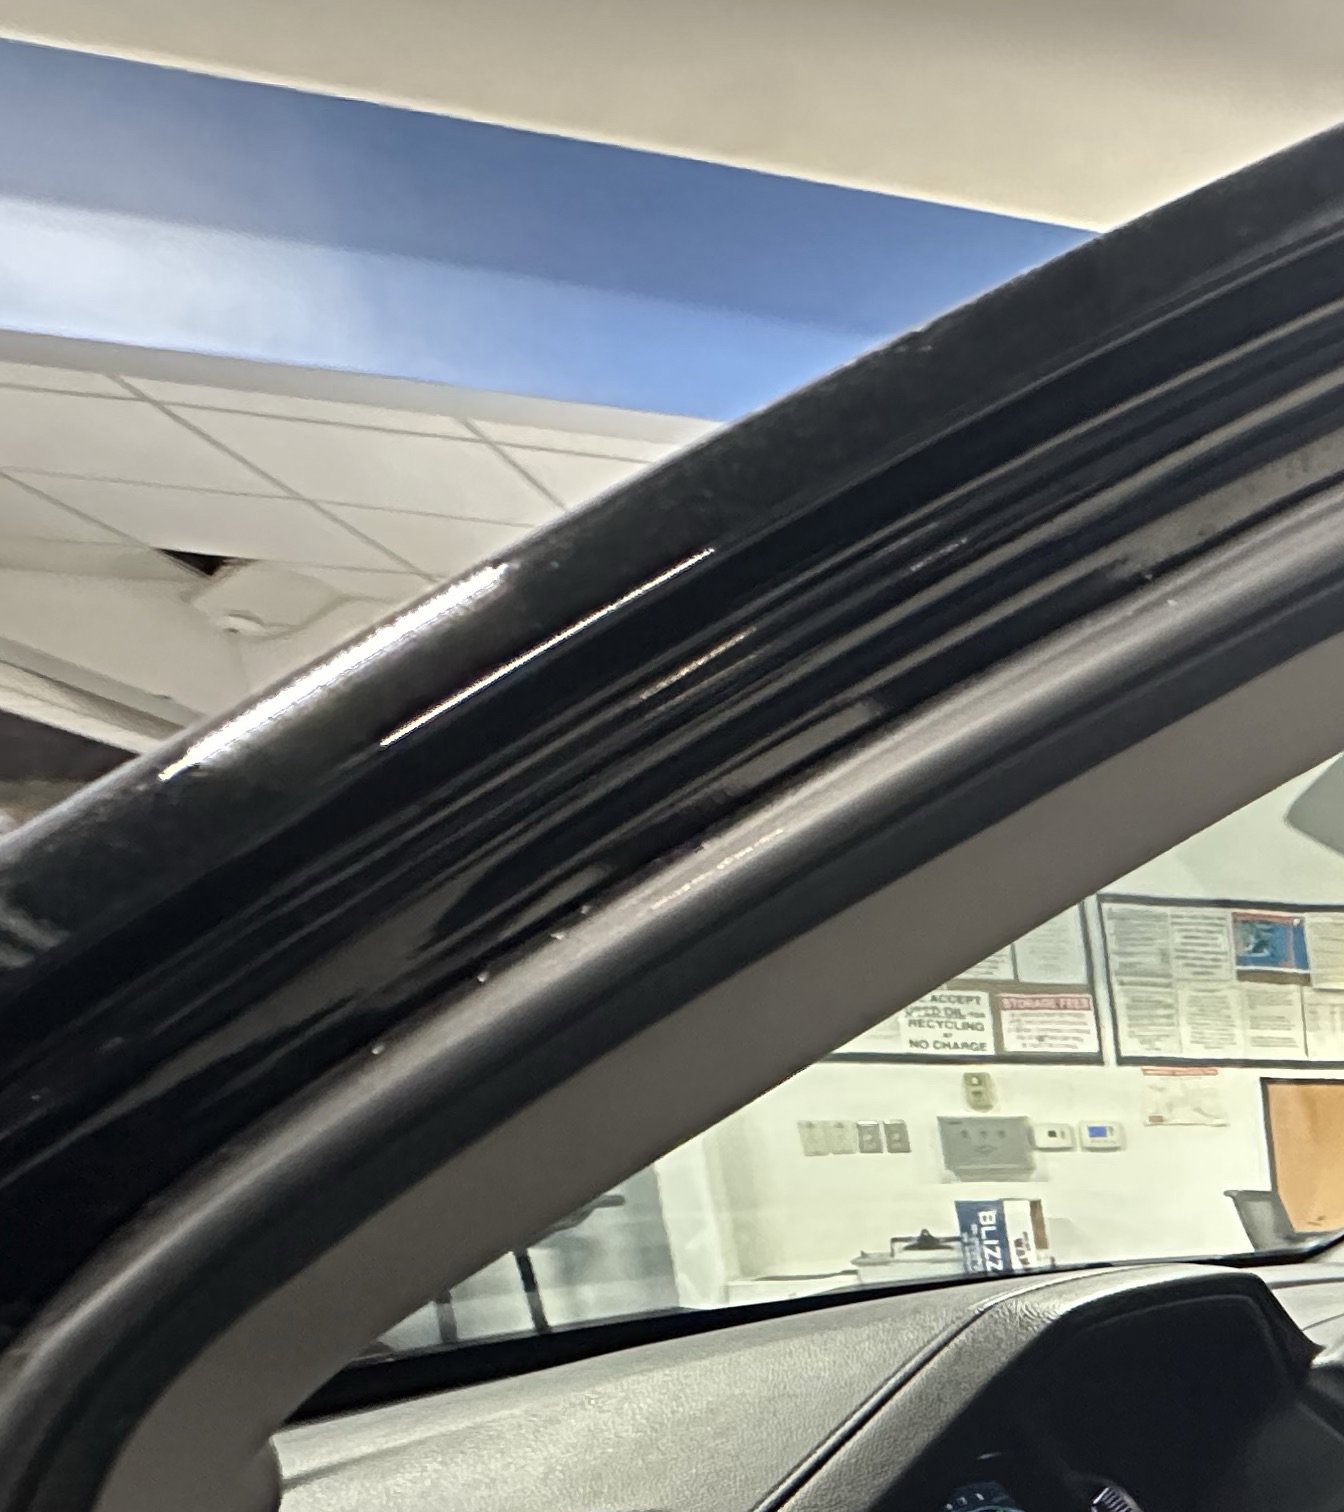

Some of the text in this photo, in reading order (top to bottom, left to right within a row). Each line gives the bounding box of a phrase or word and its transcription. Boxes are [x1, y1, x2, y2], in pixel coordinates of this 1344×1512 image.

[930, 994, 982, 1006] ACCEPT
[907, 1019, 985, 1032] RECYCLING
[908, 1039, 987, 1052] NO CHARGE
